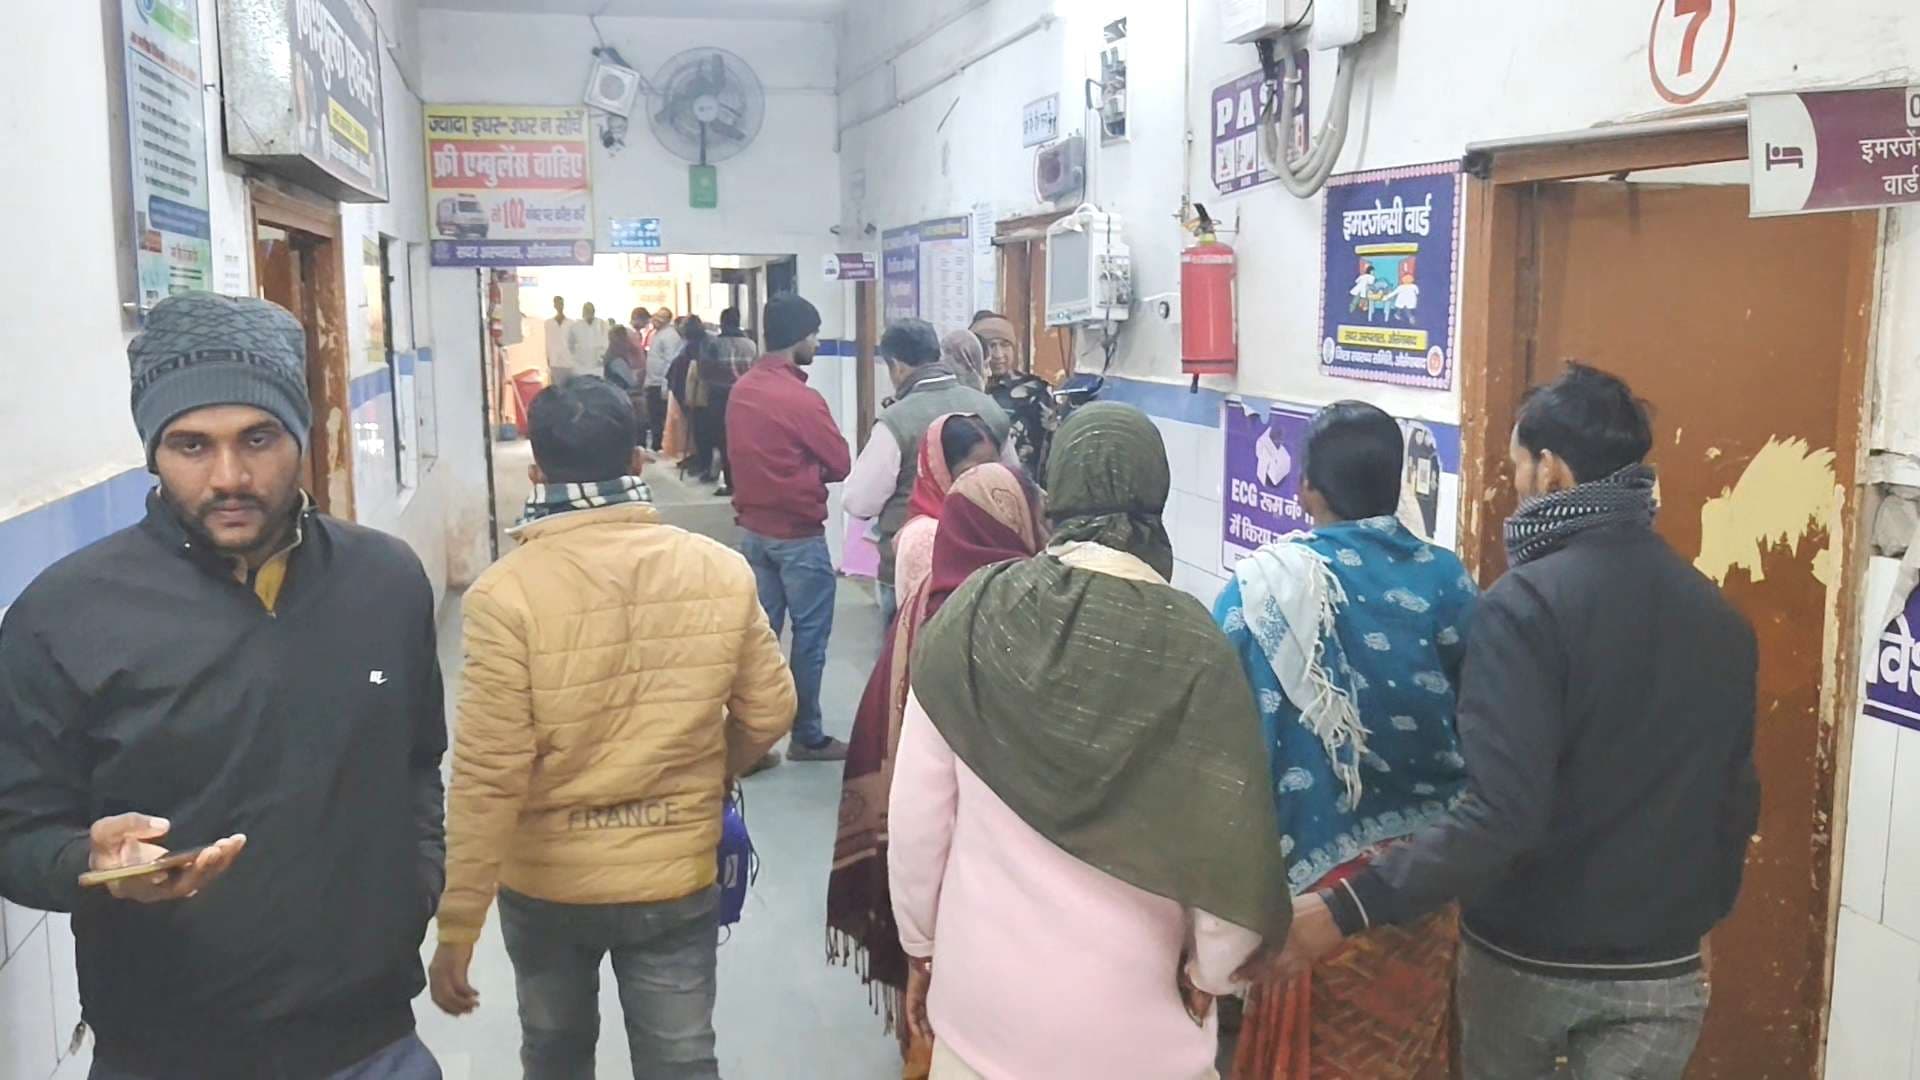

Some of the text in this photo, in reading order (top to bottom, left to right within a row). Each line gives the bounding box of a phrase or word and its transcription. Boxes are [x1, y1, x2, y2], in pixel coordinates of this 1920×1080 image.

[1674, 0, 1713, 77] 7
[428, 114, 467, 134] ज्यादा
[433, 143, 459, 178] फ्री
[532, 144, 583, 178] चाहिए
[1881, 165, 1919, 195] वार्ड
[503, 198, 526, 229] 102
[1343, 192, 1432, 240] इमरजेन्सी वार्ड
[1231, 478, 1258, 507] ECG
[1229, 513, 1241, 538] में
[1242, 516, 1272, 545] किया
[568, 802, 680, 832] FRANCE
